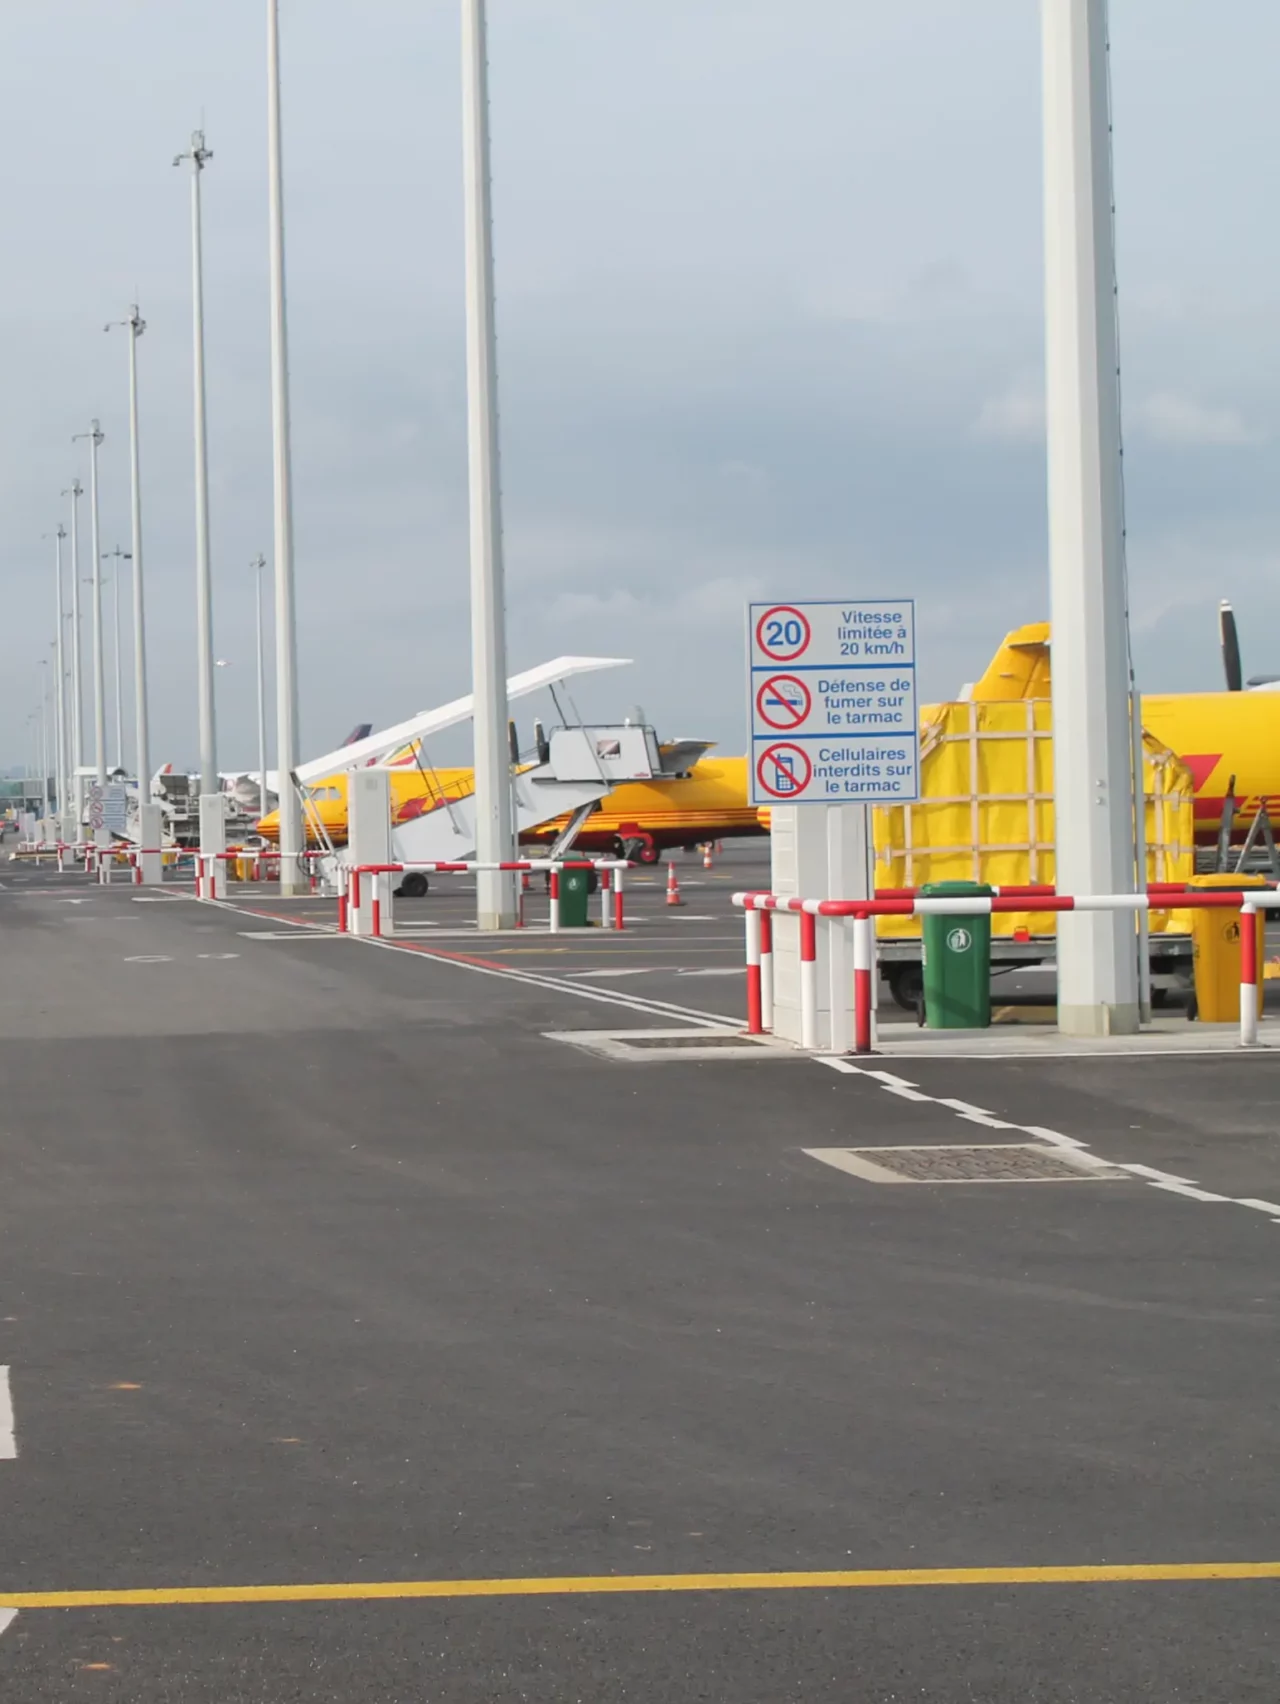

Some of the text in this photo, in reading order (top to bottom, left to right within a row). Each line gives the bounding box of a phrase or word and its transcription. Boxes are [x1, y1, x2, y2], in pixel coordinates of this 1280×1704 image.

[842, 611, 902, 623] Vitesse
[766, 620, 802, 646] 20
[837, 625, 906, 640] limitée à
[840, 642, 904, 655] 20 km/h
[818, 679, 910, 693] Défense de
[824, 696, 904, 709] fumer sur
[827, 711, 903, 724] le tarmac
[819, 748, 906, 761] Cellulaires
[813, 764, 912, 777] interdits sur
[826, 780, 901, 793] le tarmac
